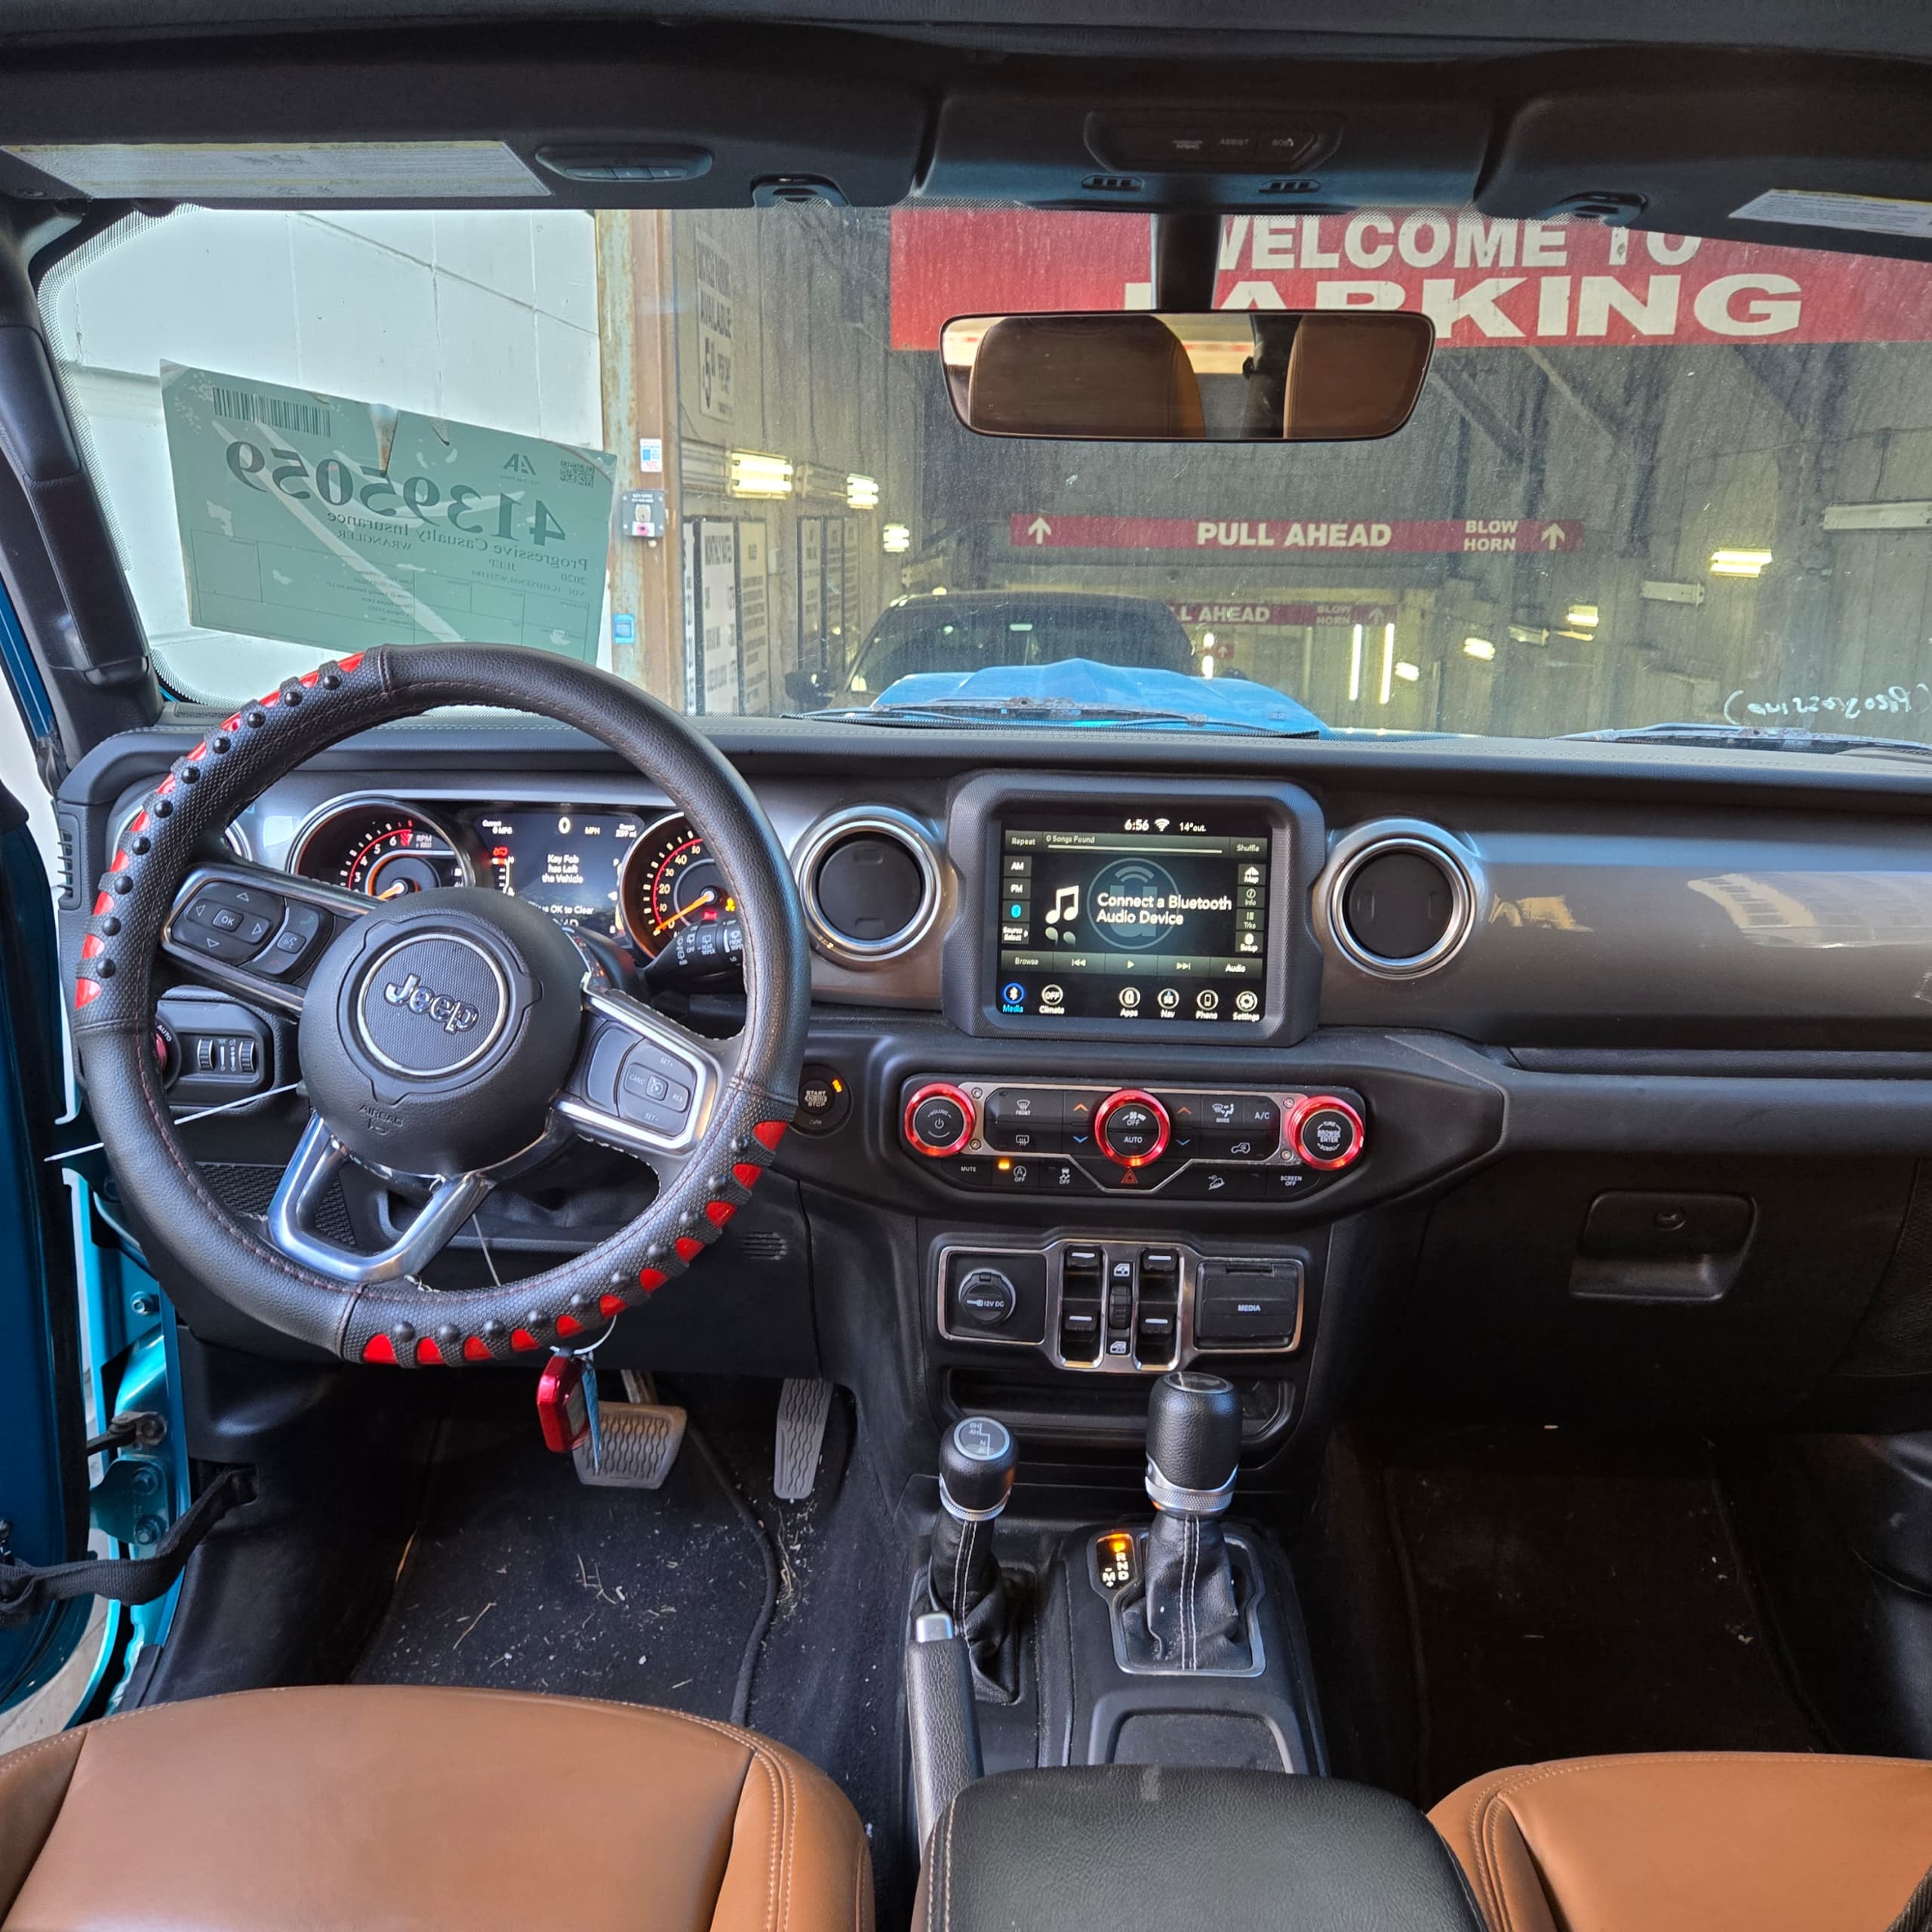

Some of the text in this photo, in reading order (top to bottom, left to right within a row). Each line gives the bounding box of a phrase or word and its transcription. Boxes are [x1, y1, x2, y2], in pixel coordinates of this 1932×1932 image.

[1464, 520, 1518, 535] BLOW
[1197, 522, 1392, 547] PULL AHEAD
[1463, 537, 1516, 552] HORN
[1198, 606, 1271, 623] AHEAD
[1316, 616, 1352, 625] HORN
[558, 817, 571, 834] 0
[1124, 819, 1149, 831] 6:56
[584, 827, 601, 835] MPH
[389, 835, 397, 847] 6
[416, 834, 432, 842] RPM
[1011, 838, 1036, 847] Repeat
[1052, 835, 1072, 844] Songs
[1073, 835, 1096, 844] Found
[374, 843, 382, 854] 5
[1236, 844, 1260, 853] Shuffle
[360, 855, 368, 866] 4
[547, 854, 580, 866] Key Fob
[675, 854, 688, 866] 40
[547, 865, 579, 874] has Left
[1011, 861, 1025, 871] AM
[354, 871, 361, 882] 3
[665, 868, 675, 878] 30
[541, 875, 584, 884] the Vehicle
[658, 886, 671, 895] 20
[1010, 884, 1023, 894] FM
[1097, 892, 1232, 911] Connect a Bluetooth
[549, 905, 563, 915] OK
[564, 906, 574, 915] to
[574, 905, 595, 915] Clear
[659, 903, 668, 912] 10
[221, 915, 235, 926] OK
[1096, 909, 1184, 925] Audio Device
[1240, 943, 1259, 953] Setup
[1014, 956, 1039, 965] Browse
[1225, 963, 1247, 973] Audio
[1044, 991, 1060, 1001] OFF
[386, 974, 479, 1033] Jeep
[1002, 1004, 1024, 1014] Media
[1038, 1005, 1065, 1015] Climate
[1120, 1008, 1139, 1018] Apps
[1160, 1010, 1177, 1019] Nav
[1195, 1011, 1219, 1020] Phone
[1232, 1012, 1260, 1023] Settings
[156, 1023, 173, 1043] AUTO
[629, 1074, 646, 1085] CANC
[358, 1104, 405, 1128] AIRBAG
[930, 1109, 949, 1117] VOLUME
[1254, 1111, 1270, 1120] A/C
[1124, 1136, 1143, 1144] AUTO
[1238, 1304, 1261, 1312] MEDIA
[1116, 1552, 1127, 1561] R
[1117, 1561, 1129, 1571] N
[1103, 1571, 1116, 1583] M
[1118, 1571, 1130, 1581] D
